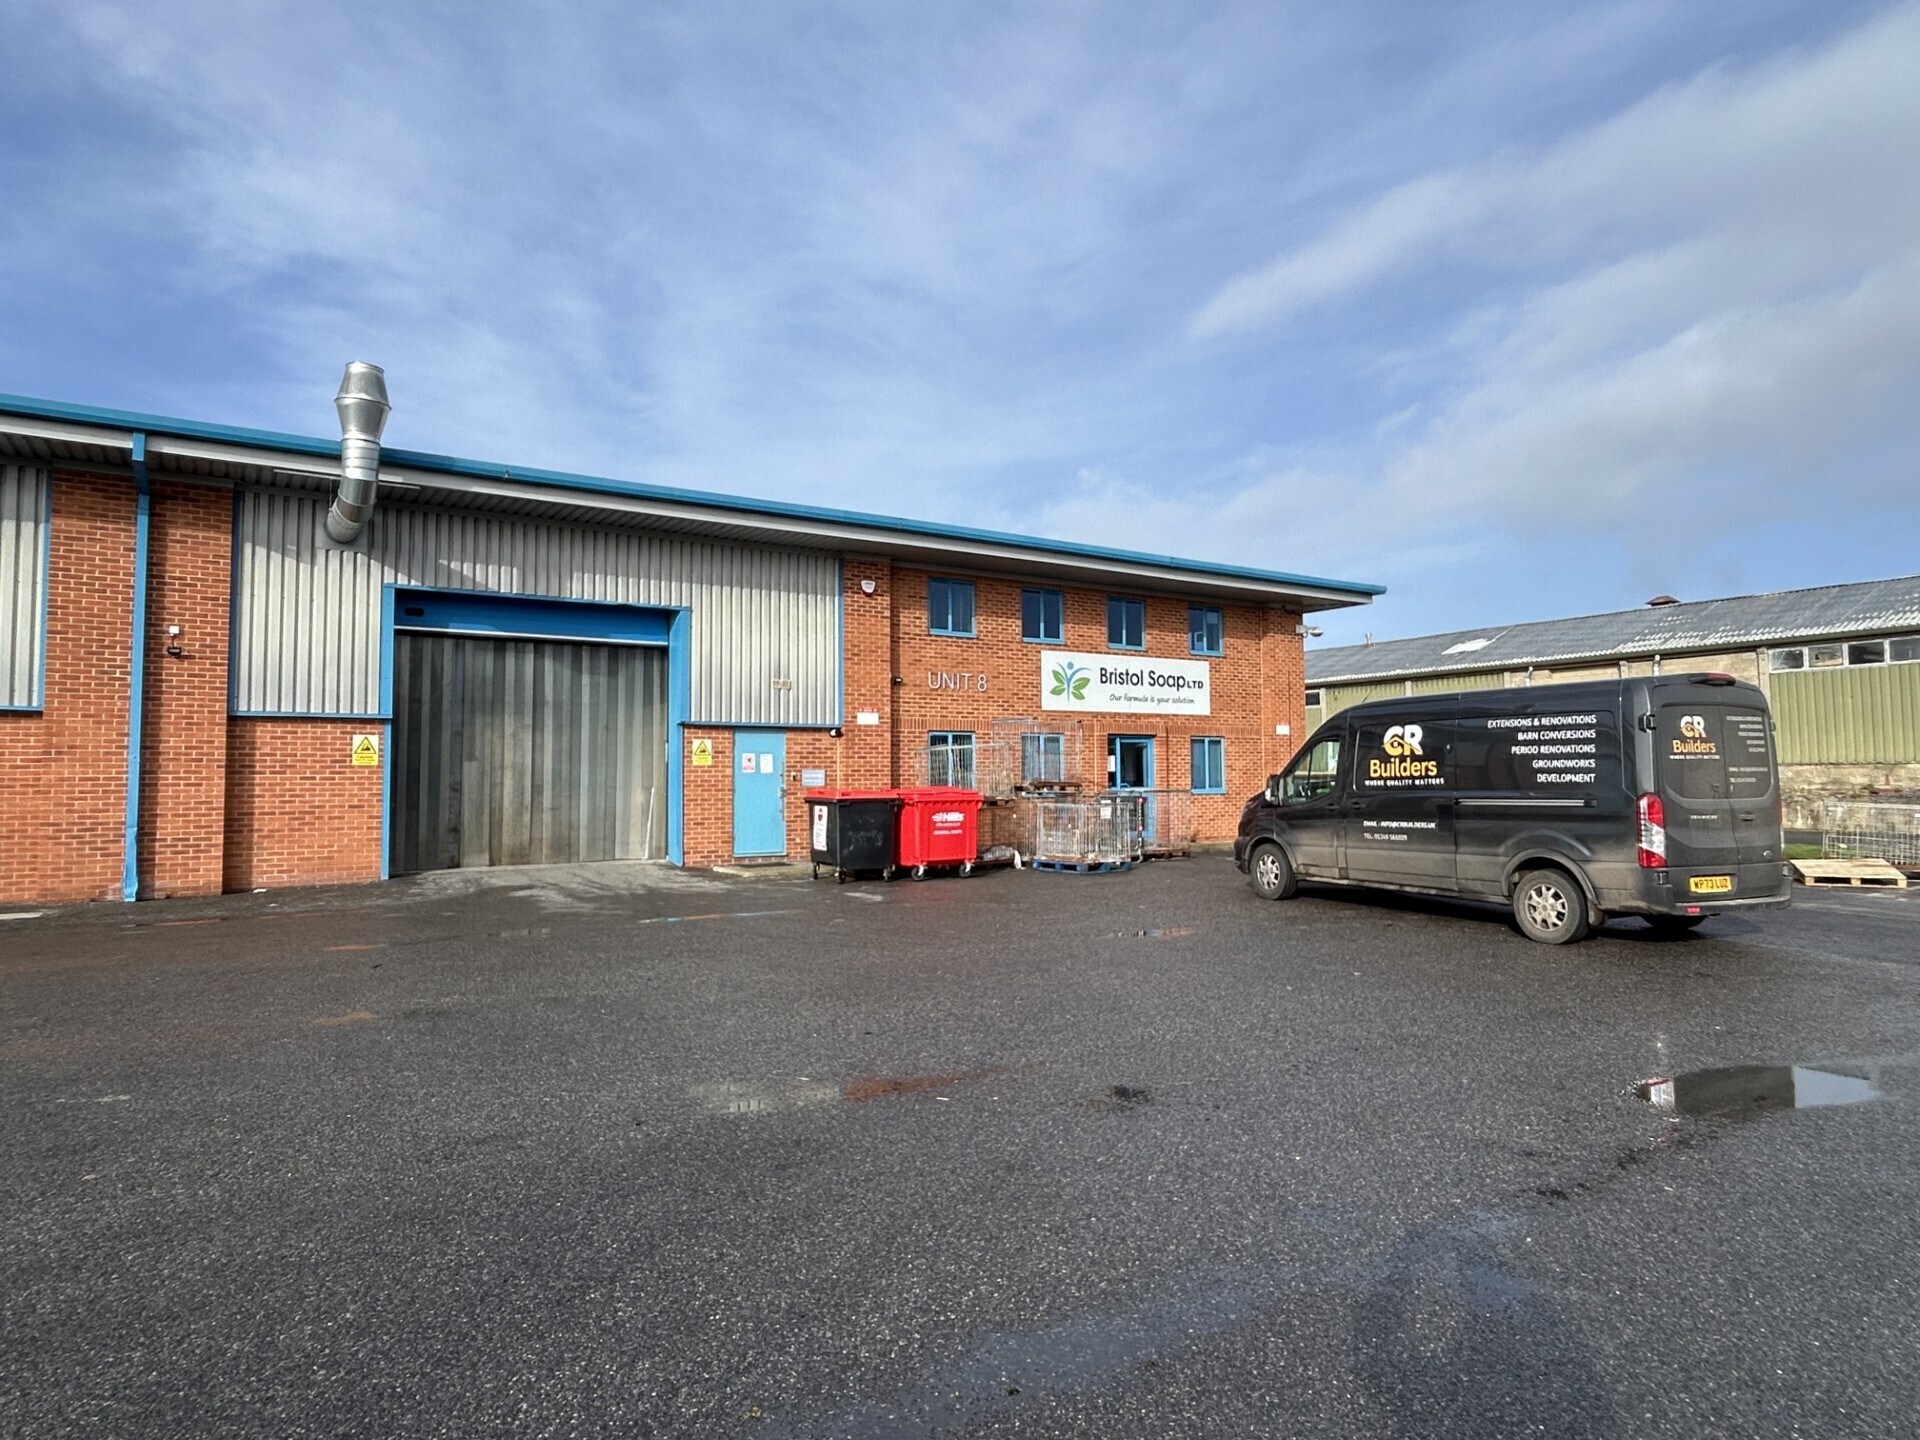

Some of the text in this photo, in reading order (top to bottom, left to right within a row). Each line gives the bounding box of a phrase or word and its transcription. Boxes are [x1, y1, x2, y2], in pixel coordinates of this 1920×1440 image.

[928, 671, 987, 692] UNIT 8
[1100, 667, 1204, 691] Bristol Soap LTD
[1109, 693, 1195, 705] Our formula is your solution
[1487, 715, 1597, 728] EXTENSIONS & RENOVATIONS
[1518, 730, 1596, 740] BARN CONVERSIONS
[1511, 744, 1596, 755] PERIOD RENOVATIONS
[1672, 739, 1717, 753] Builders
[1370, 757, 1438, 777] Builders
[1532, 759, 1596, 768] GROUNDWORKS
[1386, 779, 1413, 787] QUALITY
[1414, 778, 1445, 786] MATTERS
[1537, 774, 1596, 783] DEVELOPMENT
